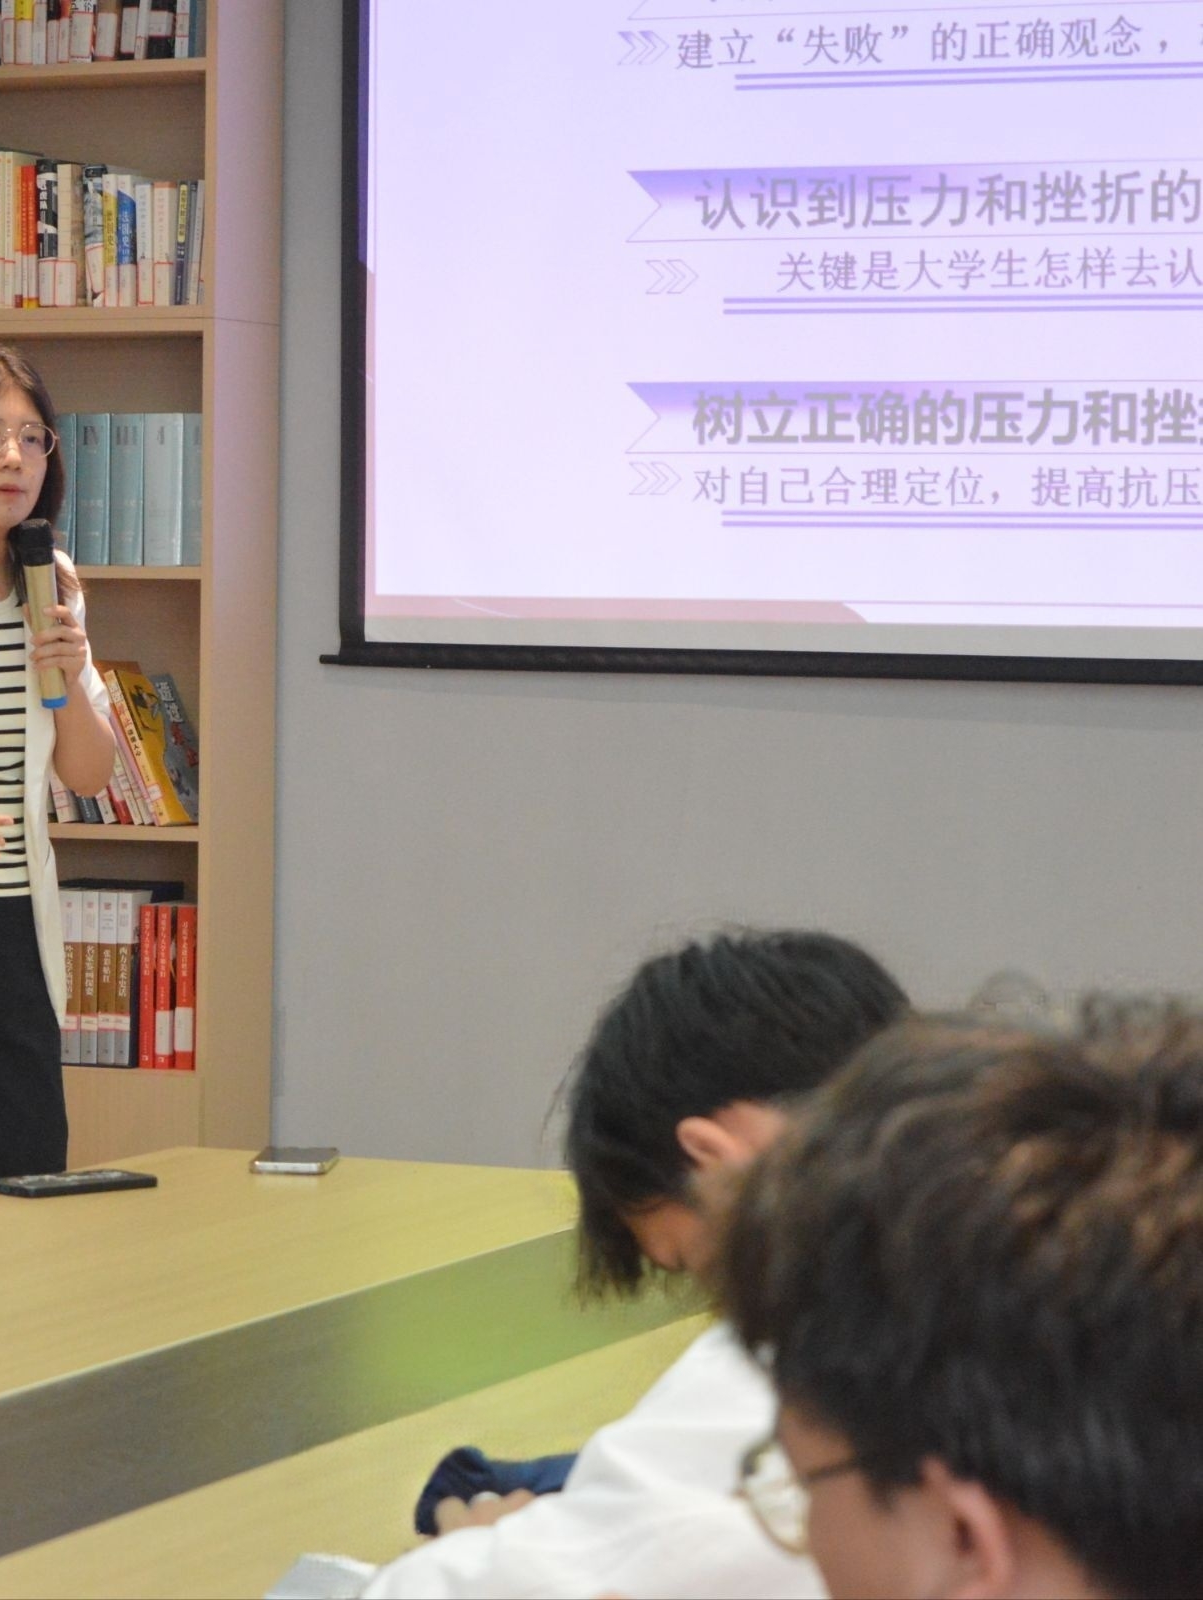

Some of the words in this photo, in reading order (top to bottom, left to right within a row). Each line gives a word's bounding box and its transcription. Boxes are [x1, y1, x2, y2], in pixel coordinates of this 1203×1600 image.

[676, 14, 1203, 69] 建立“失败”的正确观念，
[696, 168, 1202, 231] 认识到压力和挫折的
[776, 246, 1203, 293] 关键是大学生怎样去认
[692, 387, 1203, 446] 树立正确的压力和挫
[692, 465, 1203, 510] 对自己合理定位，提高抗压
